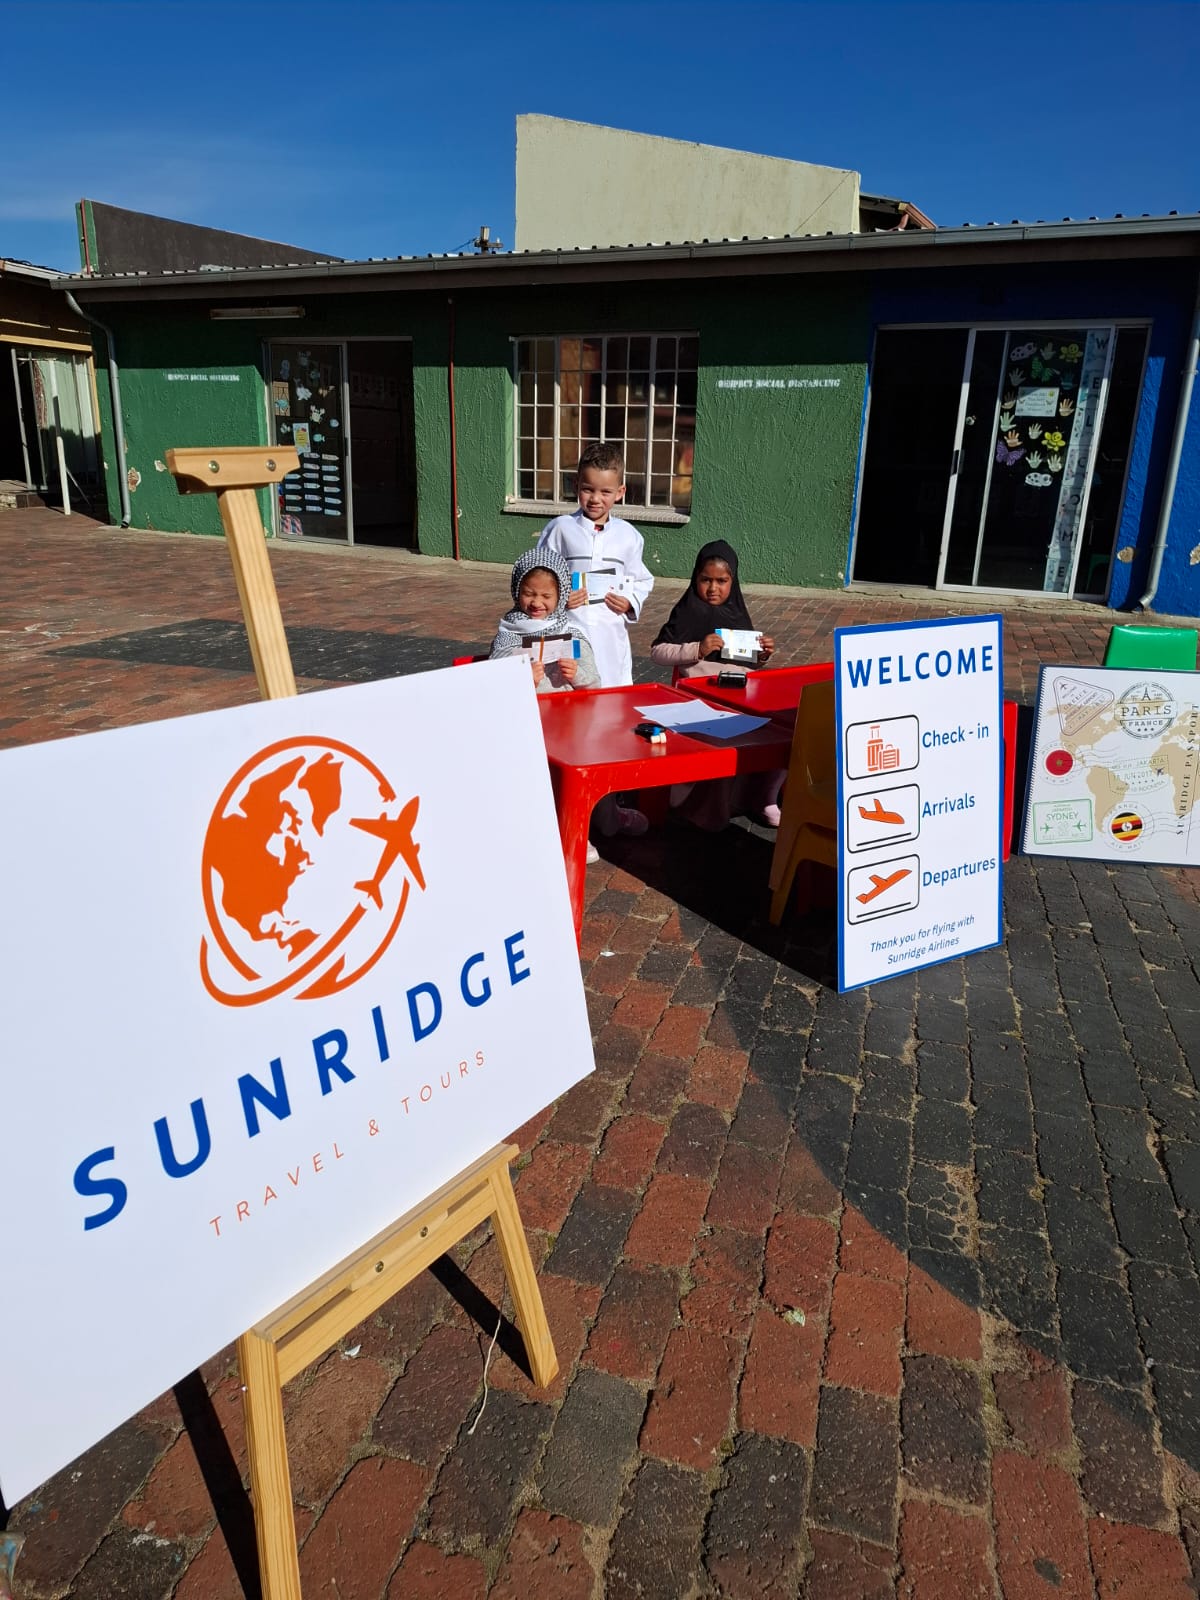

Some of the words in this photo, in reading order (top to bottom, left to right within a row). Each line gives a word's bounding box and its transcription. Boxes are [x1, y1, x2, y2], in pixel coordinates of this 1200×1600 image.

[788, 379, 840, 388] DISTANCING
[847, 645, 994, 688] WELCOME
[1121, 704, 1172, 717] PARIS
[921, 726, 965, 749] Check
[1175, 775, 1191, 836] SUNRIDGE
[1184, 704, 1200, 767] PASSPORT
[921, 791, 976, 818] Arrivals
[1046, 811, 1079, 822] SYDNEY
[922, 857, 997, 888] Departures
[870, 936, 898, 952] Thank
[899, 934, 916, 947] you
[917, 928, 931, 939] for
[932, 921, 956, 936] flying
[957, 914, 975, 928] with
[887, 946, 926, 964] Sunridge
[928, 937, 960, 952] Airlines
[73, 930, 532, 1231] SUNRIDGE
[208, 1142, 345, 1237] TRAVEL
[367, 1119, 380, 1137] &
[400, 1050, 487, 1115] TOURS
